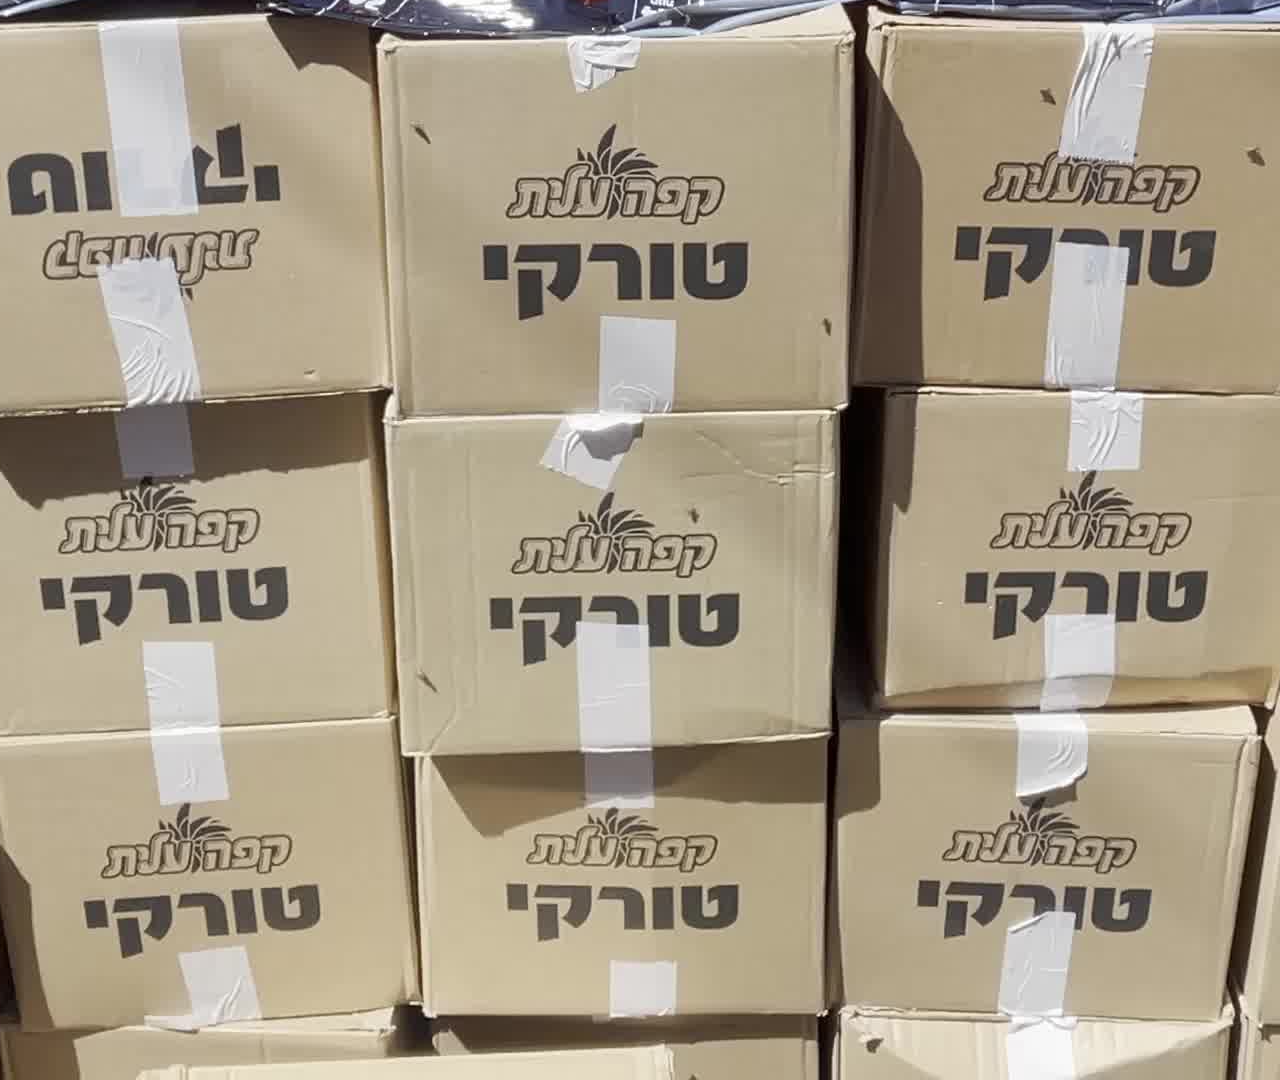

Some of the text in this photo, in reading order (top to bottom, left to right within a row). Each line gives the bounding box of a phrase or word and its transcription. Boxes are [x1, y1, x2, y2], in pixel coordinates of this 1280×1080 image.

[7, 123, 281, 216] טוקי
[506, 161, 726, 225] קפה עלית
[983, 151, 1201, 213] קפה עלית
[482, 241, 750, 321] טורקי
[954, 225, 1217, 302] טוקי
[58, 501, 261, 554] קפה עלית
[511, 523, 719, 578] קפה עלית
[989, 499, 1193, 556] קפה עלית
[39, 565, 290, 647] טורקי
[489, 592, 741, 667] טורקי
[963, 570, 1209, 641] טורקי
[100, 830, 293, 880] קפה עלית
[526, 824, 720, 873] קפה עלית
[942, 820, 1139, 875] קפה עלית
[83, 883, 322, 959] טורקי
[506, 883, 740, 943] טורקי
[916, 878, 1153, 940] טורקי
